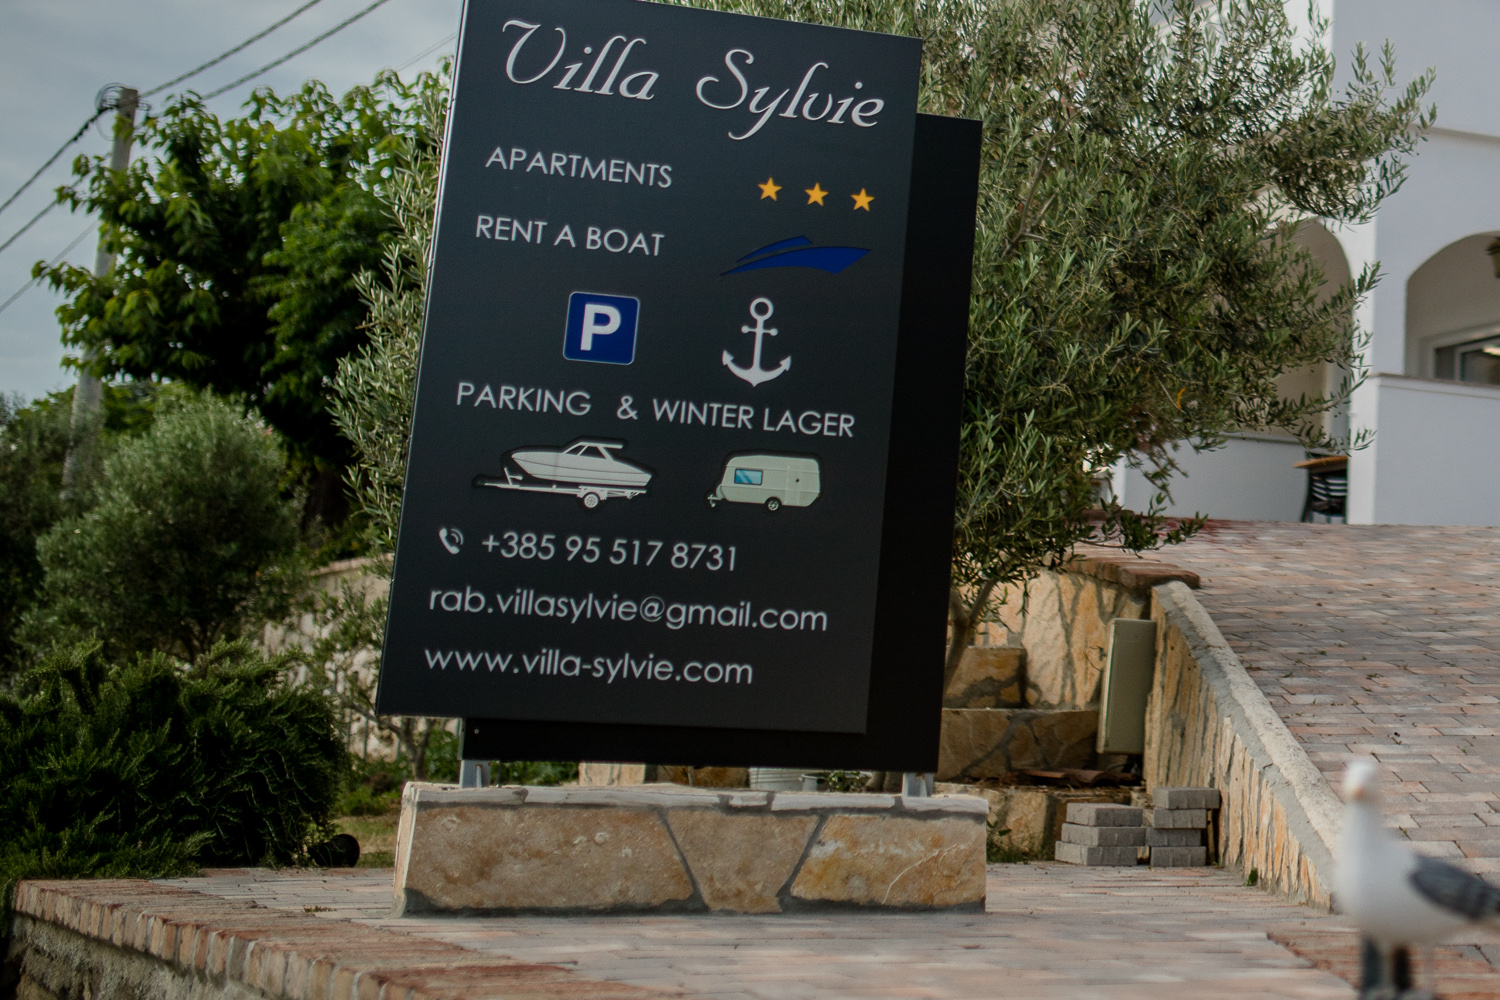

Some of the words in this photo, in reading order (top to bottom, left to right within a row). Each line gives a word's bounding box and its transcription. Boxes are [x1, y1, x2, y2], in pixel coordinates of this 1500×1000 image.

[502, 19, 659, 101] Villa
[695, 48, 885, 141] Sylvie
[484, 146, 672, 189] APARTMENTS
[475, 214, 548, 244] RENT
[553, 224, 576, 248] A
[585, 226, 665, 257] BOAT
[580, 302, 622, 352] P
[456, 381, 591, 416] PARKING
[616, 395, 638, 420] &
[652, 398, 754, 430] WINTER
[763, 407, 855, 438] LAGER
[481, 531, 556, 561] +385
[565, 535, 601, 564] 95
[609, 538, 664, 567] 517
[670, 542, 736, 572] 8731
[429, 585, 828, 632] rab.villasylvie@gmail.com
[424, 648, 753, 685] www.villa-sylvie.com
